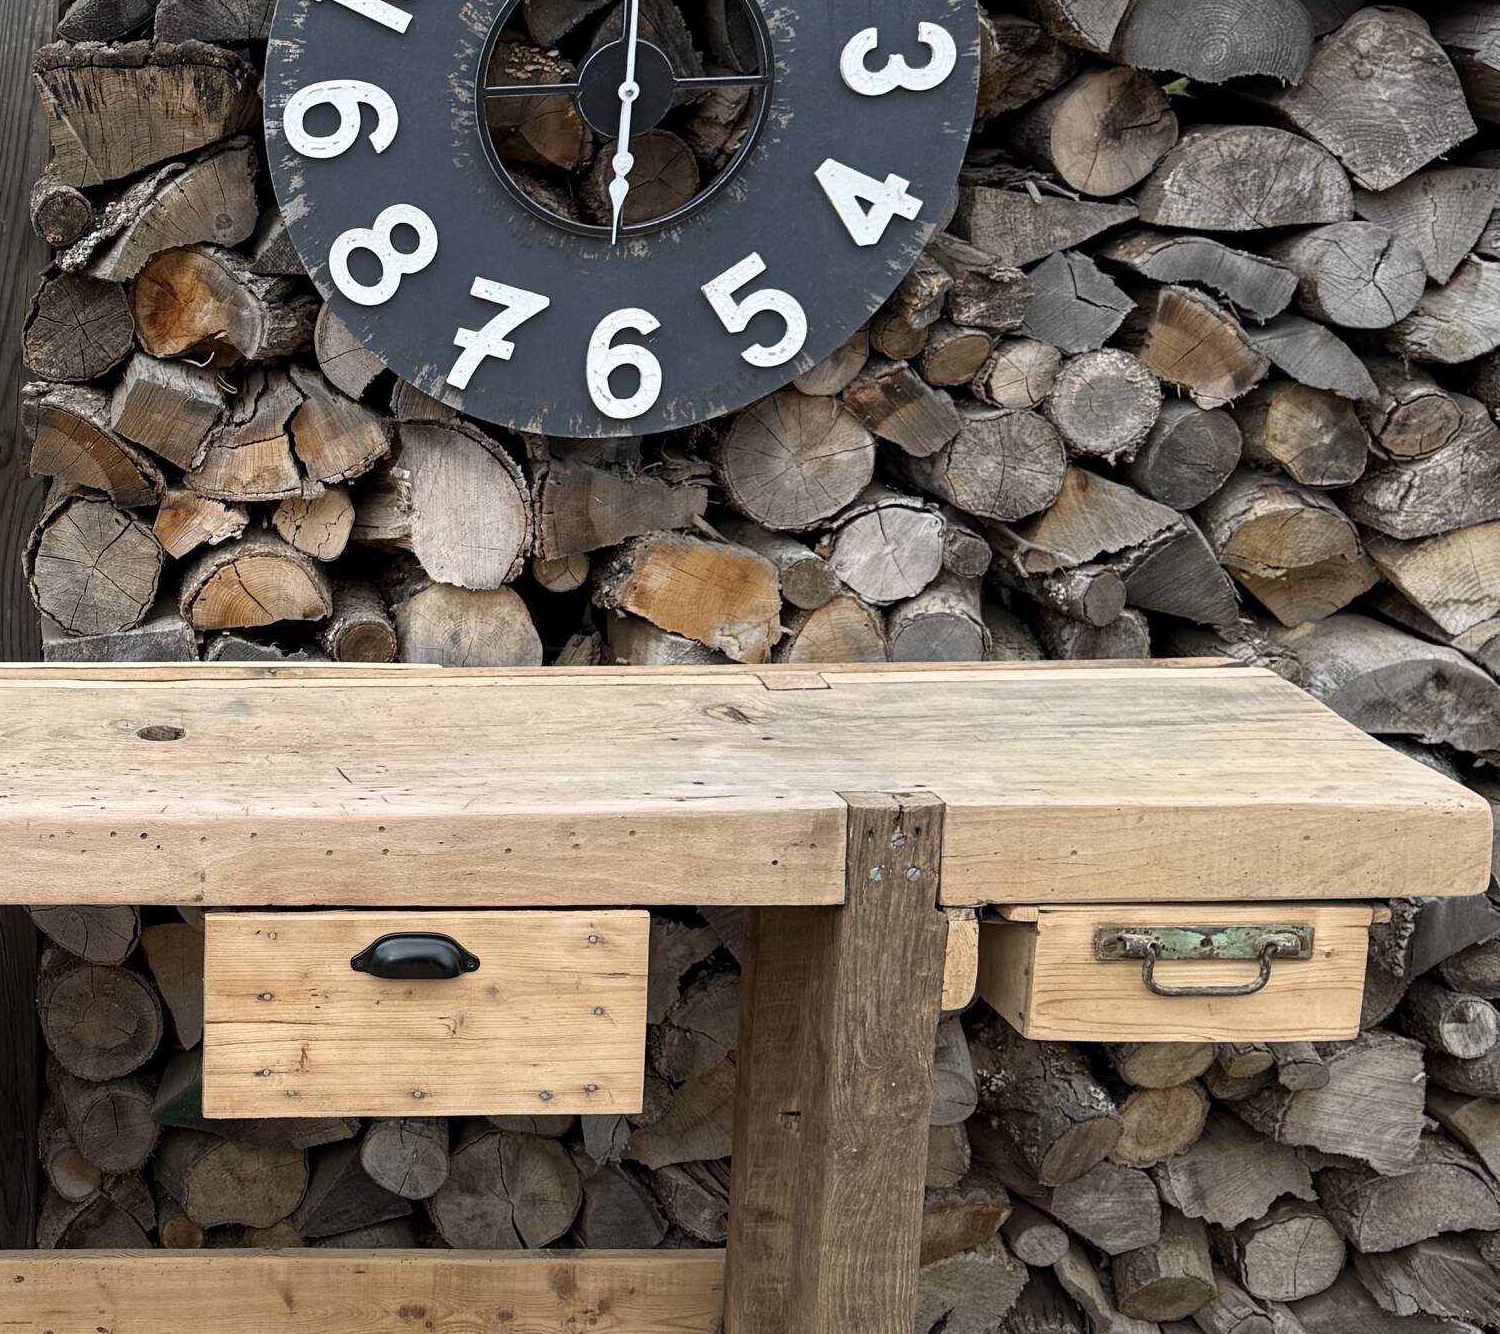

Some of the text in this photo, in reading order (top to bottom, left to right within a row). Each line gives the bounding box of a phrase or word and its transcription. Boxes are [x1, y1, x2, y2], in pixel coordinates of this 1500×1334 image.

[840, 22, 956, 95] 3
[282, 80, 398, 158] 9
[815, 159, 923, 246] 4
[329, 204, 437, 305] 8
[447, 277, 549, 389] 7
[701, 252, 807, 367] 5
[587, 308, 661, 418] 6
